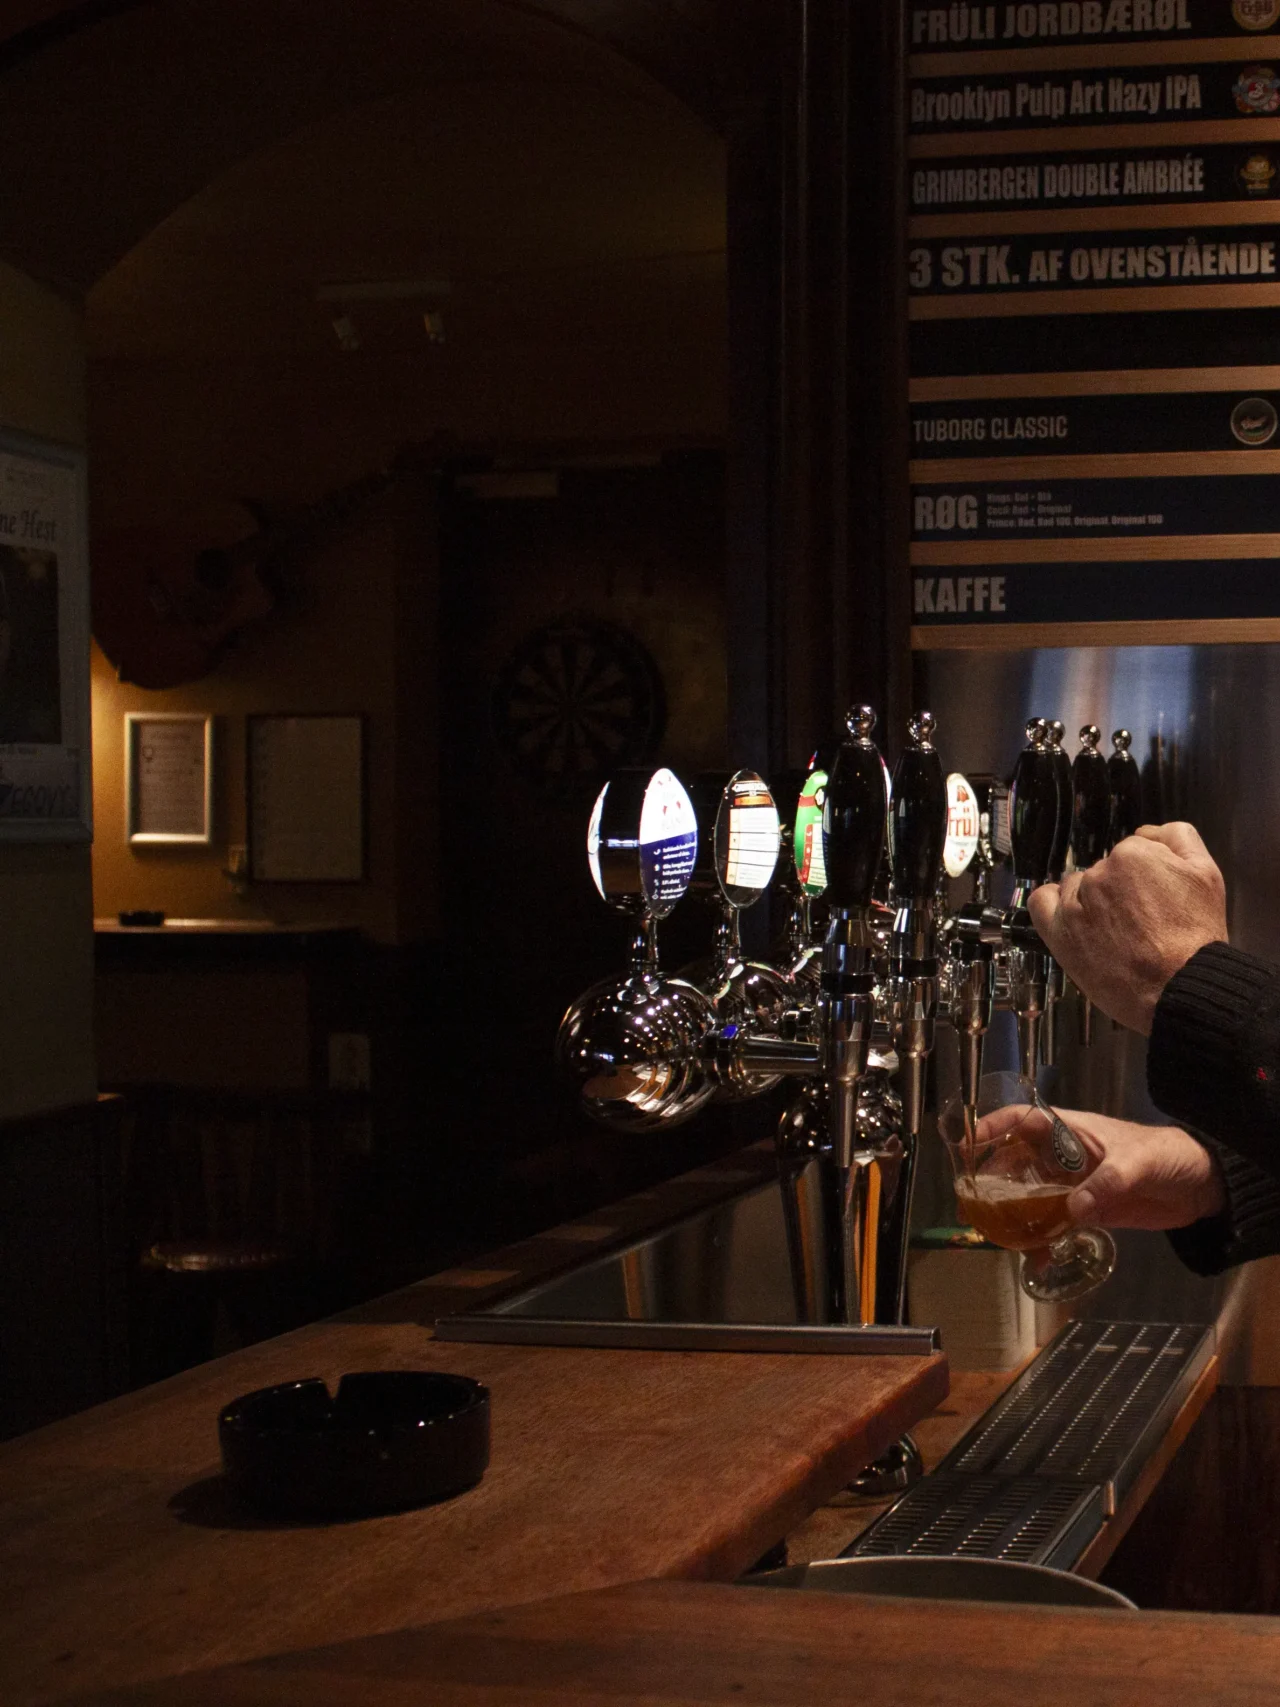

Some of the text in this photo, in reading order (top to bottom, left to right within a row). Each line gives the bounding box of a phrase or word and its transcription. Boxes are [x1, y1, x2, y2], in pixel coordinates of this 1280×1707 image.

[912, 2, 996, 43] FRÜLI
[910, 73, 1202, 123] Brooklyn Pulp Art Hazy IPA
[913, 153, 1205, 205] GRIMBERGEN DOUBLE AMBRÉE
[909, 236, 1276, 289] 3 STK. AF OVENSTÅENDE
[912, 415, 1068, 443] TUBORG CLASSIC
[914, 494, 979, 531] RØG
[914, 576, 1006, 613] KAFFE
